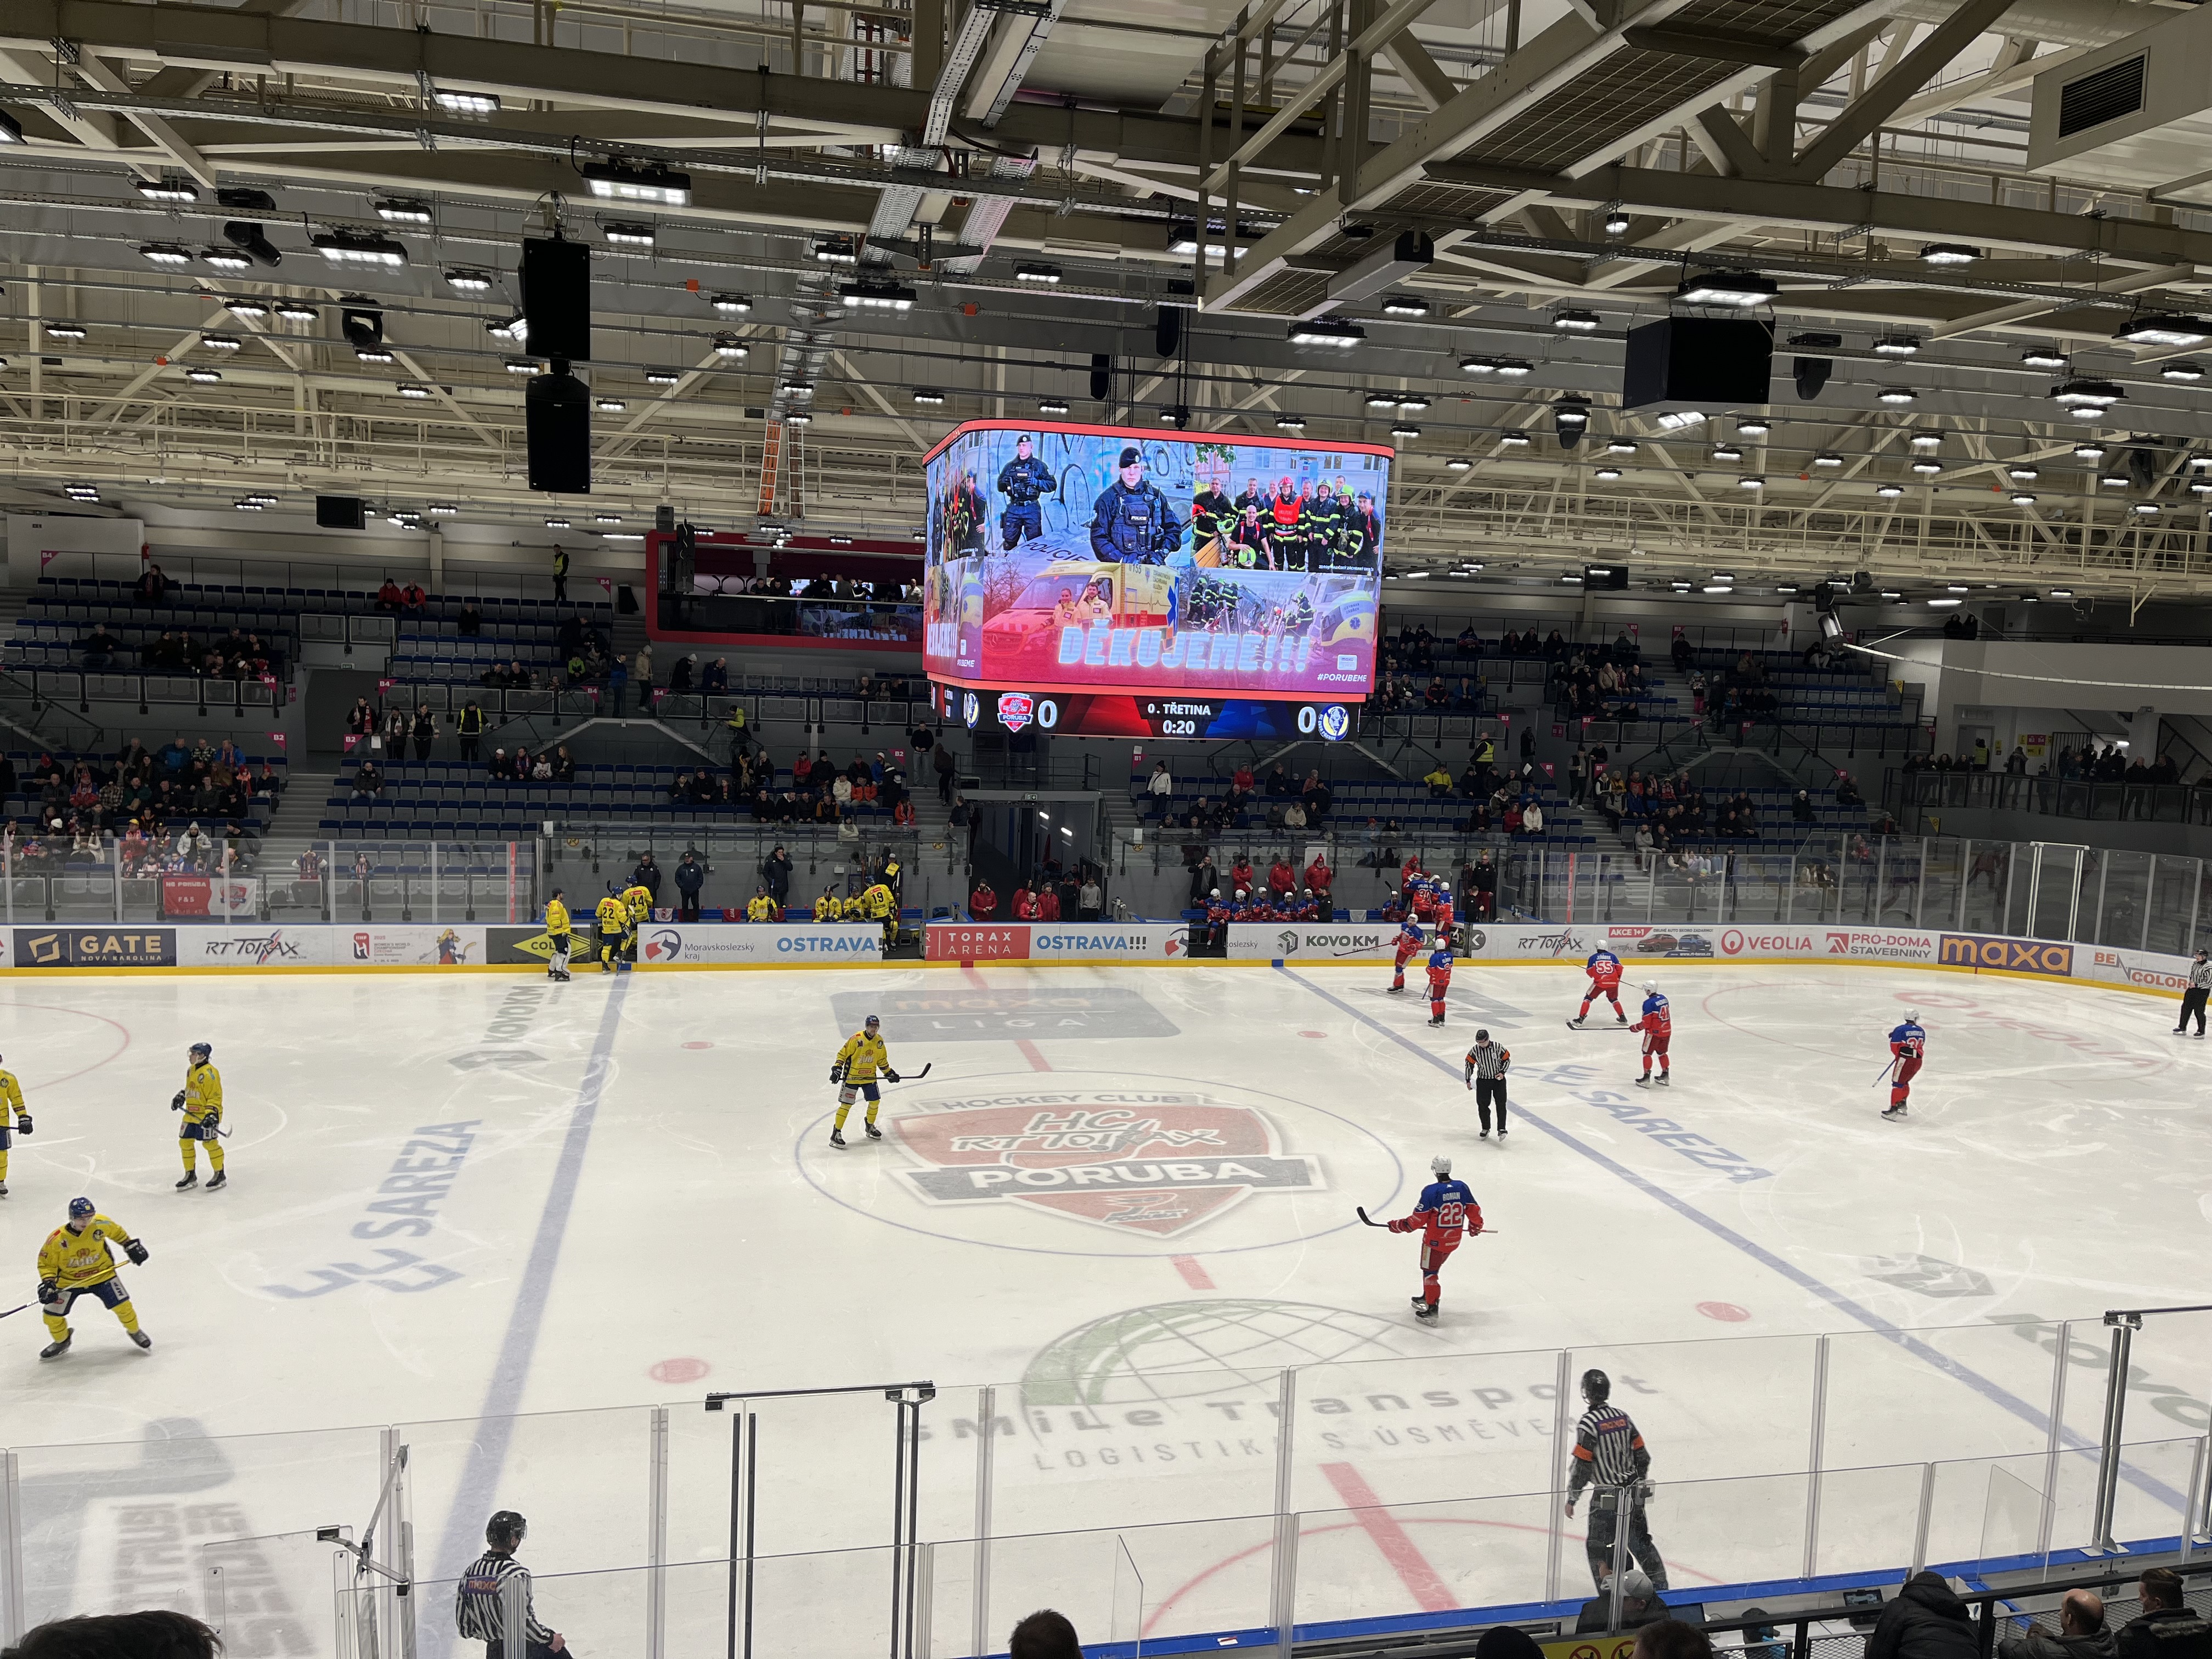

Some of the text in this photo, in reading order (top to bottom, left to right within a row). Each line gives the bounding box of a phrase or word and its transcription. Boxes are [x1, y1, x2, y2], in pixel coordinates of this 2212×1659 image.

[1059, 619, 1310, 672] DĚKUJEME!!!
[1317, 673, 1367, 682] #PORUBEME
[1038, 700, 1057, 727] 0
[1163, 702, 1211, 715] TŘETINA
[1298, 706, 1316, 733] 0
[1163, 720, 1195, 734] 0:20
[630, 895, 645, 907] 44
[872, 892, 884, 904] 19
[603, 907, 614, 919] 22
[948, 932, 1011, 942] TORAX
[1036, 935, 1147, 950] OSTRAVA!!!
[1518, 934, 1583, 950] RT TORAX
[1748, 936, 1813, 950] VEOLIA
[1852, 934, 1932, 948] PRO-DOMA
[80, 935, 161, 954] GATE
[206, 938, 301, 956] RT TORAX
[685, 943, 755, 952] Moravskoslezský
[948, 945, 1011, 955] ARENA
[685, 952, 701, 961] kraj
[1850, 946, 1931, 958] STAVEBNINY
[1942, 938, 2071, 972] maxa
[1595, 960, 1614, 974] 55
[2131, 971, 2188, 989] COLOR
[895, 997, 1092, 1009] maxa
[932, 1018, 1087, 1029] LIGA
[942, 1093, 1184, 1111] HOCKEY CLUB
[1030, 1111, 1133, 1130] HC
[957, 1137, 1032, 1151] RT
[1567, 1090, 1774, 1184] SAREZA
[351, 1119, 483, 1240] SAREZA
[969, 1161, 1267, 1189] PORUBA
[1438, 1201, 1464, 1228] 22
[1319, 1432, 1346, 1449] S
